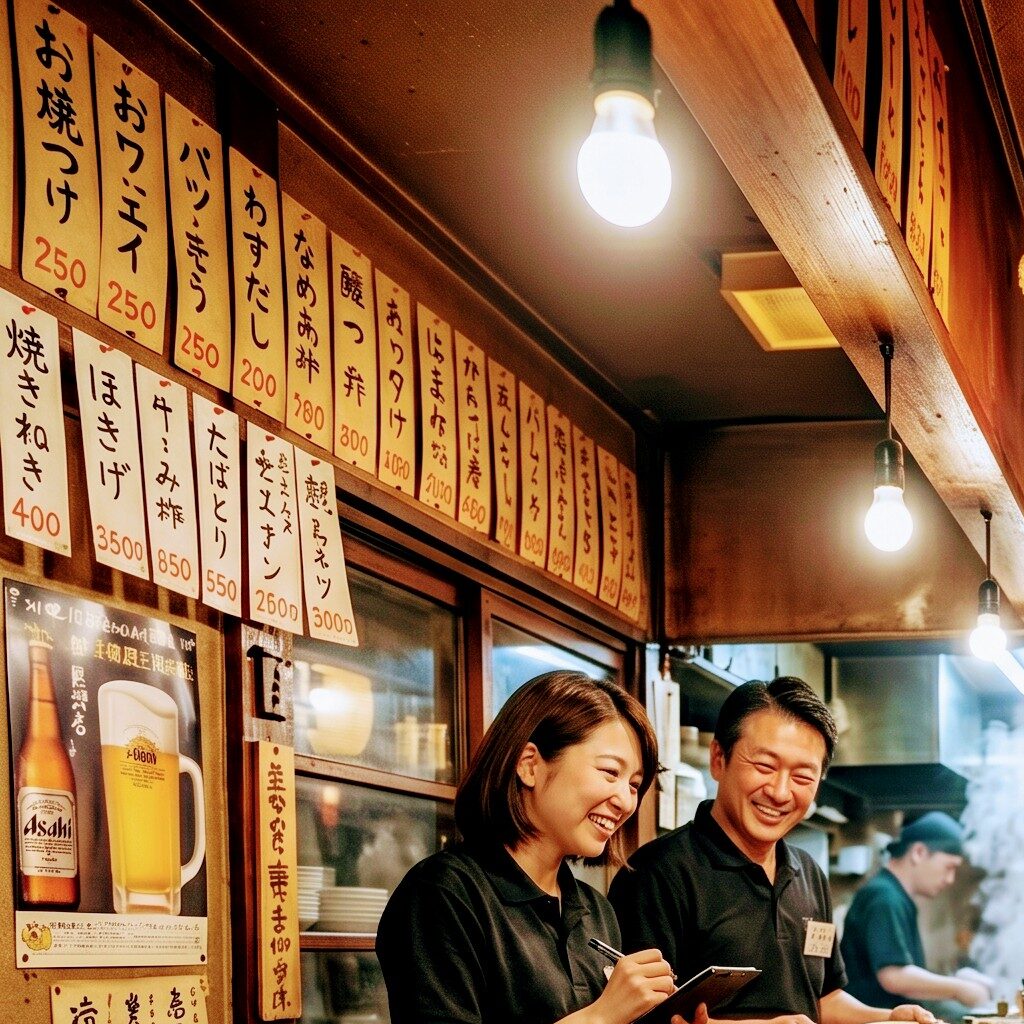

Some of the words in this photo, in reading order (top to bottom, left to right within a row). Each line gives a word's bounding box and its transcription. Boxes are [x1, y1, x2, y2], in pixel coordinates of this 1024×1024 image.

[35, 236, 87, 289] 250
[107, 281, 157, 330] 250
[181, 325, 220, 369] 250
[240, 358, 277, 398] 200
[12, 497, 61, 538] 400
[96, 525, 144, 562] 3500
[158, 549, 192, 582] 850
[207, 569, 238, 602] 550
[255, 589, 299, 622] 2600
[24, 814, 72, 839] Asahi
